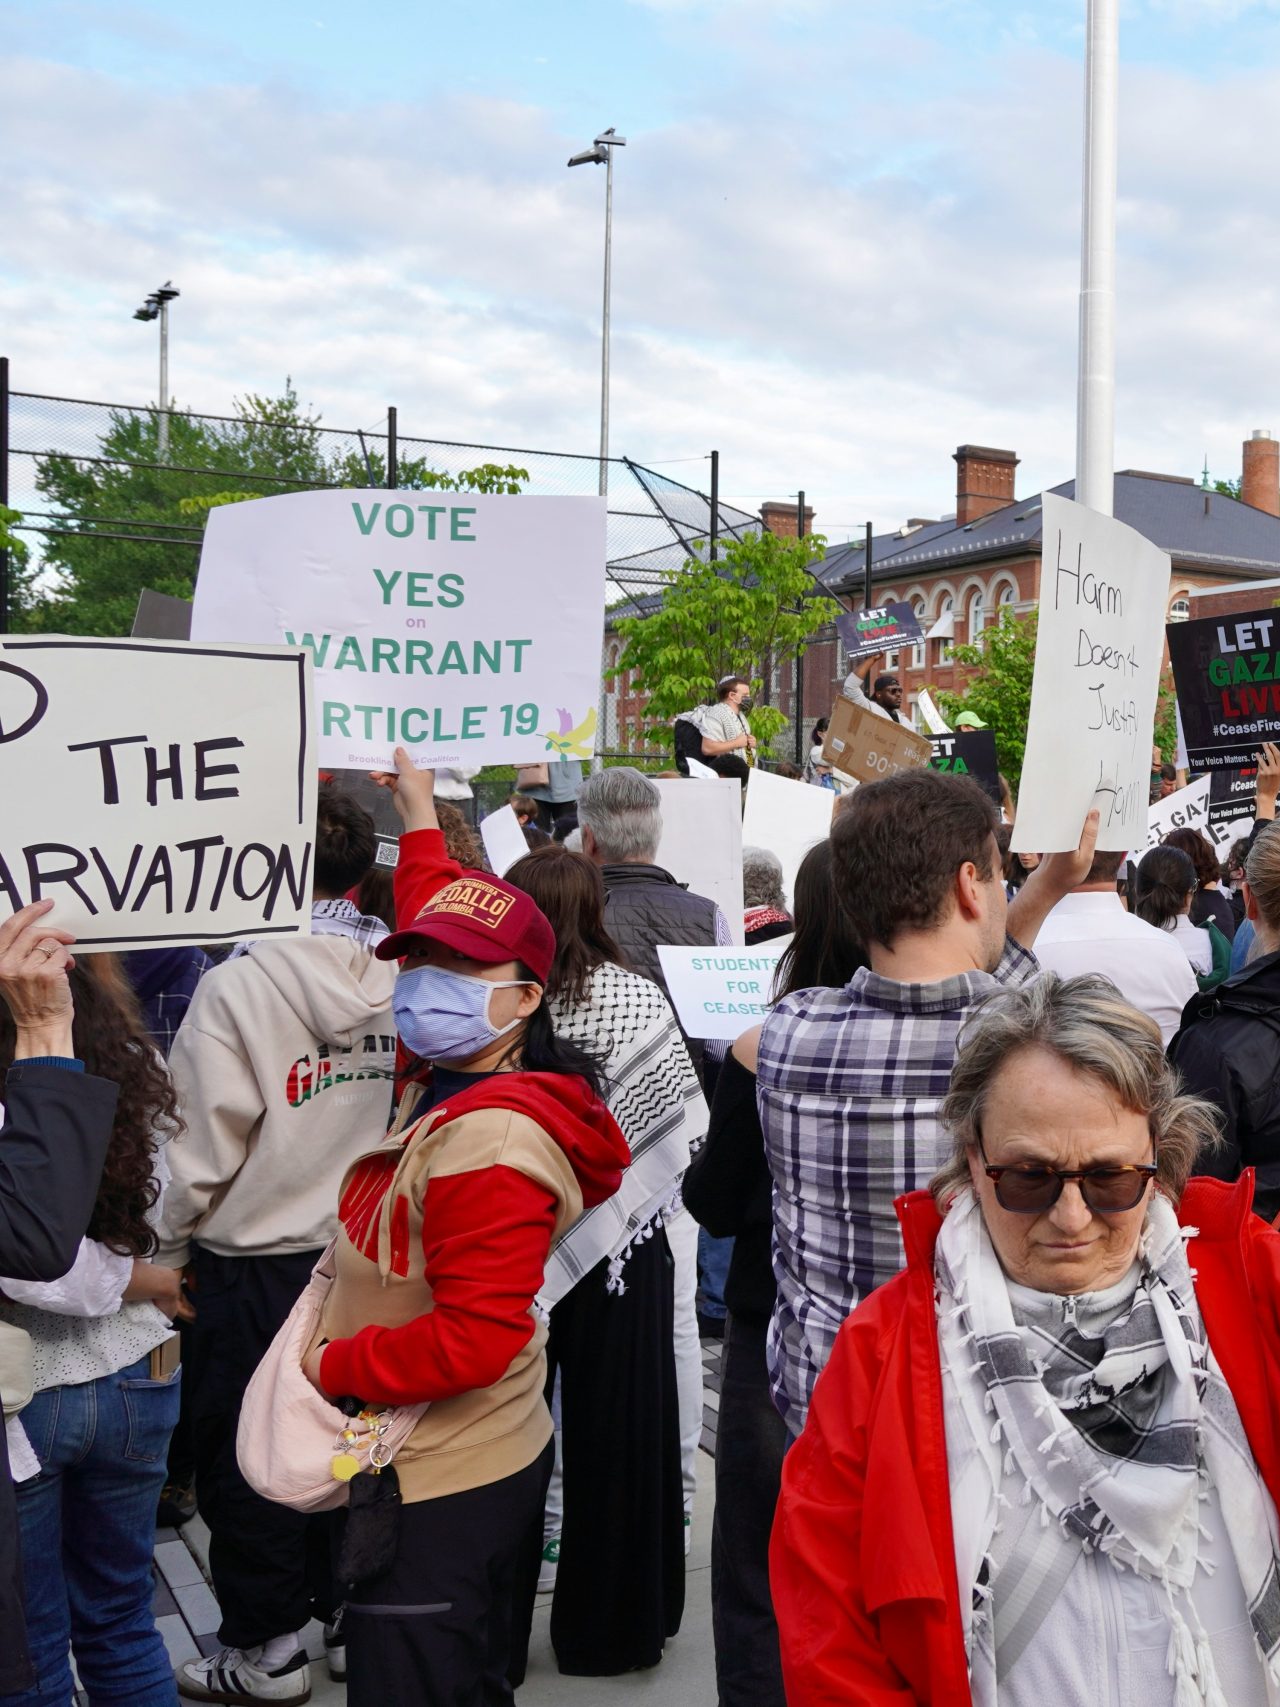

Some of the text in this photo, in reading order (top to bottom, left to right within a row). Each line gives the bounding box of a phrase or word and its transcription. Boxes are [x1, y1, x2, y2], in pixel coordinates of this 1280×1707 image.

[351, 502, 477, 542] VOTE
[1055, 528, 1122, 617] Harm
[373, 568, 465, 609] YES
[405, 617, 426, 629] on
[859, 608, 887, 621] LET
[856, 616, 898, 631] GAZA
[863, 624, 897, 640] LIVE
[1217, 619, 1274, 654] LET
[284, 631, 533, 676] WARRANT
[1074, 628, 1139, 678] Doesn't
[322, 700, 540, 744] RTICLE 19
[929, 738, 956, 757] ET
[420, 754, 460, 764] Coalition
[1190, 758, 1205, 767] Your
[1205, 756, 1224, 766] Voice
[1224, 754, 1250, 764] Matters.
[67, 735, 245, 806] THE
[1170, 793, 1210, 827] GAZ
[461, 880, 498, 897] PRIMAVERA
[433, 903, 475, 915] COLOMBIA
[691, 958, 781, 971] STUDENTS
[726, 981, 761, 994] FOR
[703, 1001, 772, 1016] CEASEF
